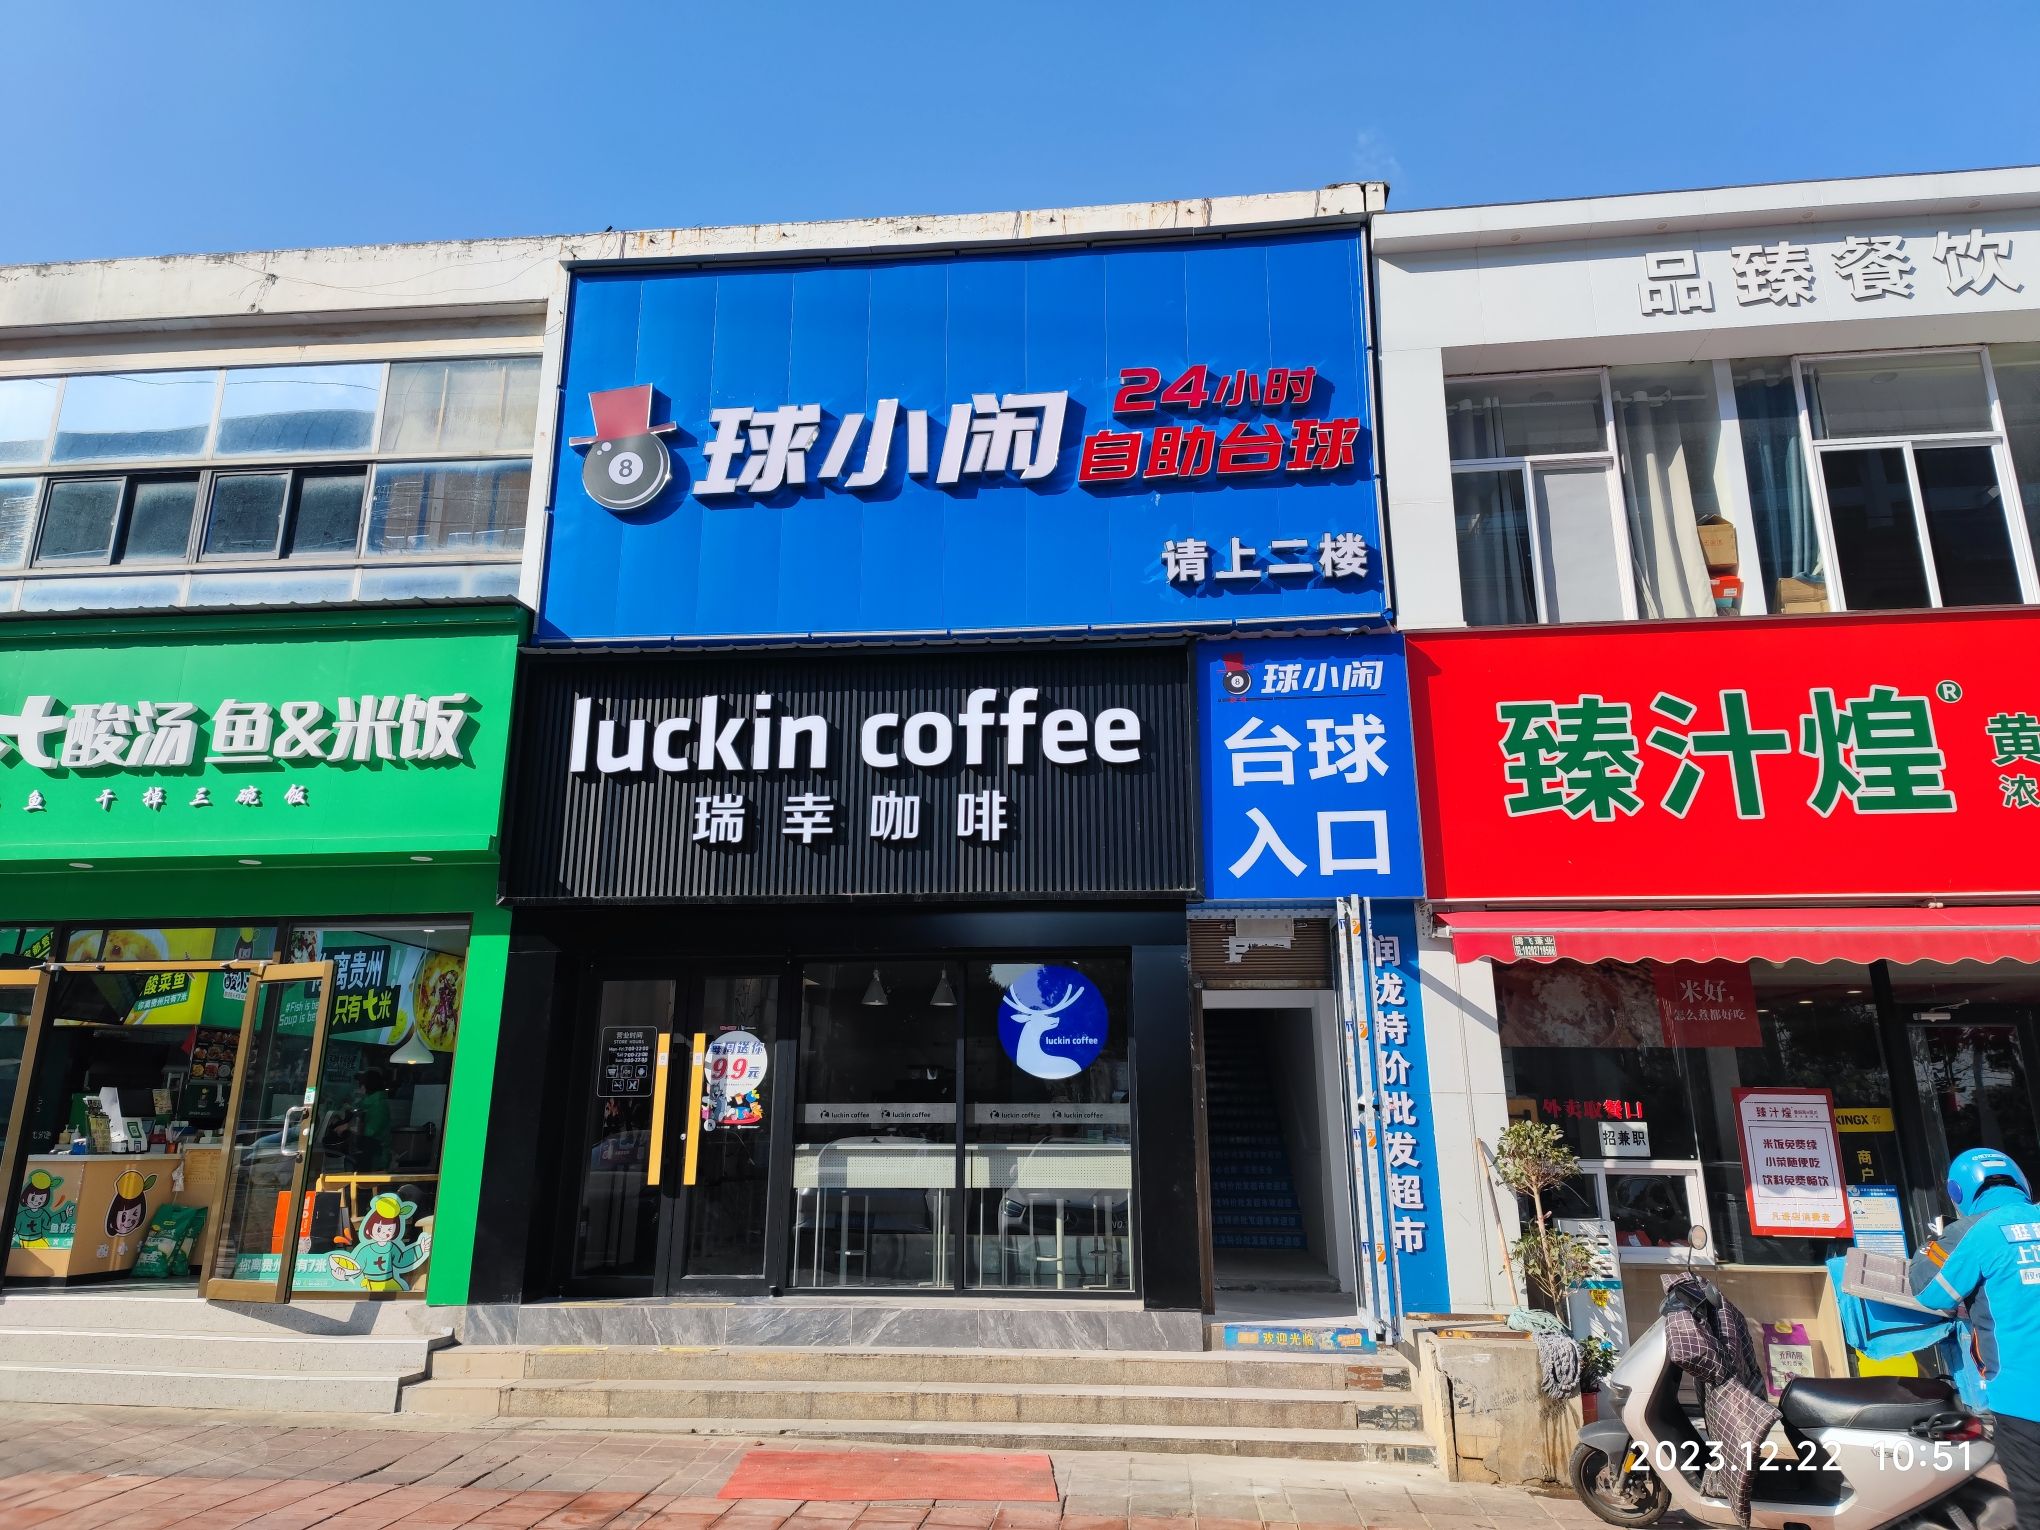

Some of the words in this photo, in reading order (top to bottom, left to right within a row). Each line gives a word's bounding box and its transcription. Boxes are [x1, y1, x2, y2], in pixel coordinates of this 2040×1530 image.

[1638, 228, 2024, 315] 品臻餐饮
[1112, 364, 1319, 413] 24小时
[693, 390, 1070, 495] 球小闹
[1078, 417, 1361, 482] 自助台球
[1161, 532, 1369, 584] 请上二楼
[1260, 661, 1384, 694] 球小闹
[0, 692, 472, 768] 七酸汤鱼&米饭
[568, 690, 829, 774] luckin
[860, 687, 1142, 768] coffee
[1223, 713, 1390, 787] 台球
[1495, 685, 1959, 822] 臻汁煌
[692, 790, 1009, 845] 瑞幸咖啡
[1228, 807, 1391, 879] 入口
[332, 989, 393, 1026] 只有七米
[1673, 1008, 1746, 1021] 怎么煮都好吃
[710, 1041, 765, 1055] 每周送你
[1045, 1035, 1071, 1045] luckin
[1072, 1035, 1098, 1045] coffee
[1370, 934, 1427, 1255] 润泷特价批发超市
[1602, 1130, 1647, 1146] 招兼职
[1762, 1138, 1818, 1150] 米饭免费续
[1765, 1156, 1821, 1169] 小菜随便吃
[1762, 1174, 1830, 1187] 饮料免费畅饮
[1263, 1332, 1314, 1347] 欢迎光临
